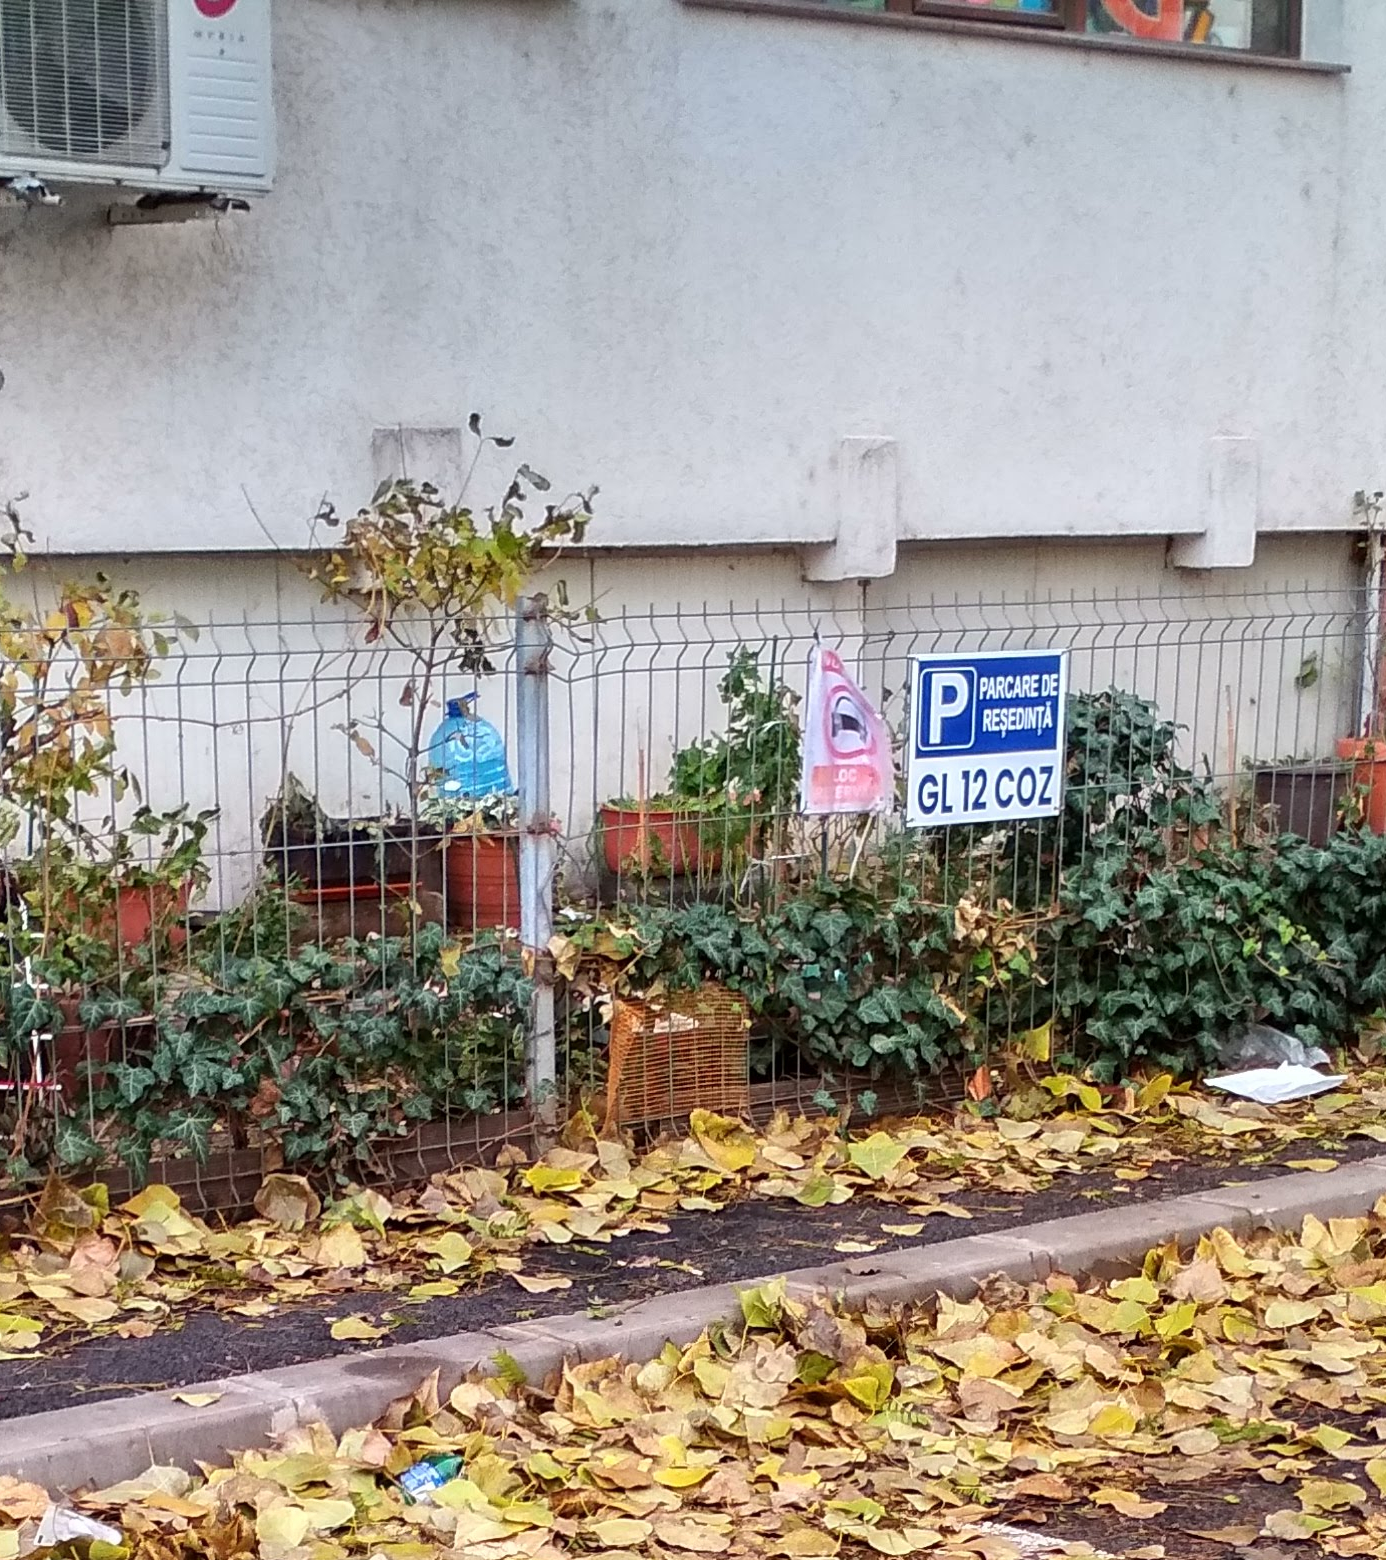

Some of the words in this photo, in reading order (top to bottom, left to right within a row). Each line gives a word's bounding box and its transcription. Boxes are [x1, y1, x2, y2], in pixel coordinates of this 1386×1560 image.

[979, 675, 1039, 700] PARCARE
[1041, 673, 1059, 697] DE
[982, 701, 1053, 738] REȘEDINȚĂ
[918, 772, 953, 815] GL
[962, 768, 988, 811] 12
[995, 765, 1054, 809] COZ
